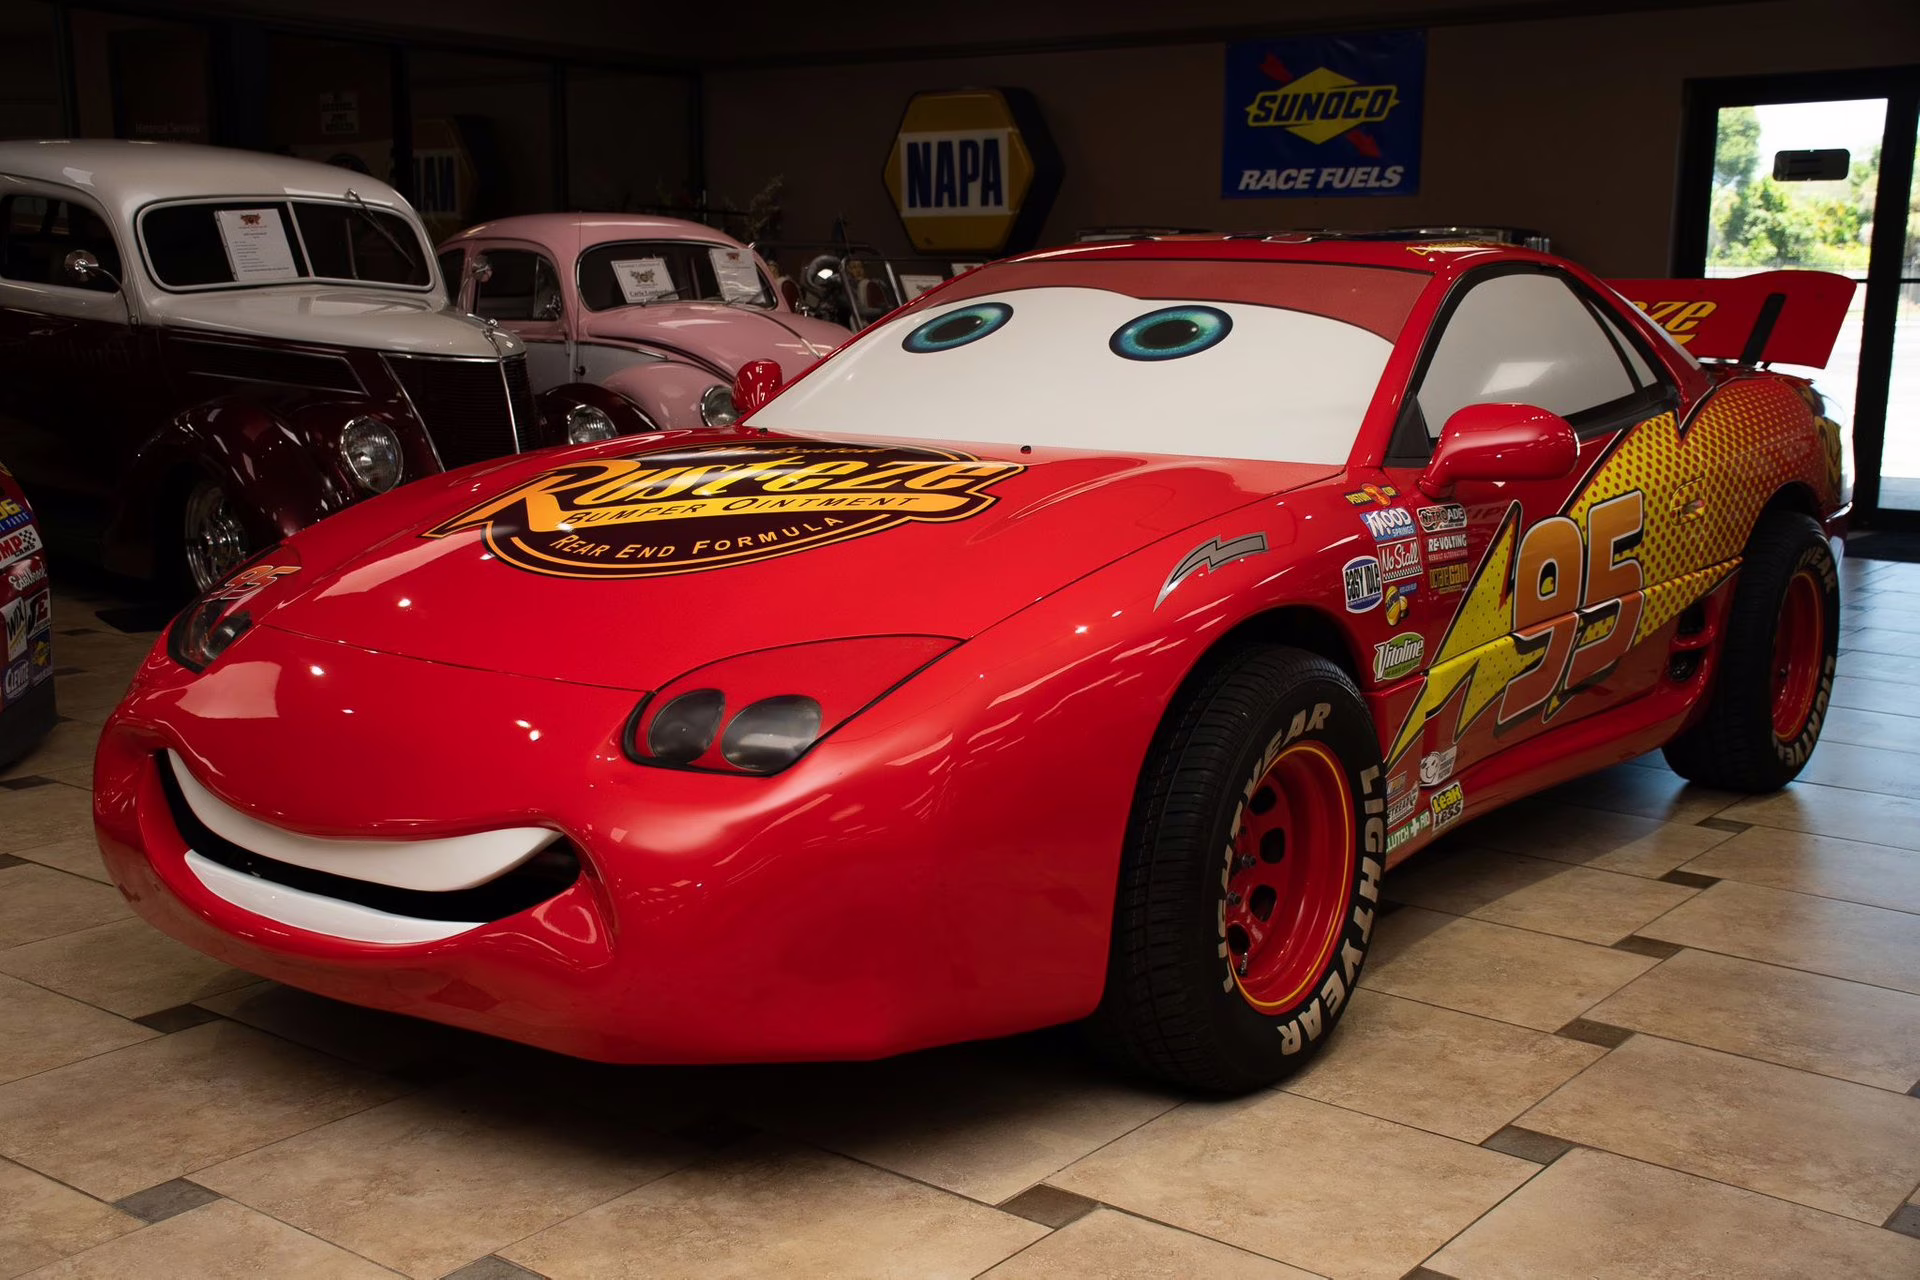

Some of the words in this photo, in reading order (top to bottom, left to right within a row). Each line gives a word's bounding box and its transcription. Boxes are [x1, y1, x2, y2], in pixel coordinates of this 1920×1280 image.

[1250, 86, 1394, 126] SUNOCO
[906, 138, 1003, 209] NAPA
[1238, 167, 1317, 191] RACE
[1319, 165, 1405, 189] FUELS
[562, 503, 707, 525] BUMPER
[722, 497, 921, 512] OINTMENT
[1366, 508, 1413, 538] MOOD
[550, 534, 610, 559] REAR
[615, 543, 675, 558] END
[692, 517, 845, 554] FORMULA
[1392, 526, 1415, 537] SPRINGS
[1382, 547, 1395, 572] No
[1394, 541, 1419, 568] Stall
[202, 565, 302, 603] 95
[7, 600, 24, 642] WIX
[1499, 489, 1645, 726] 95
[1375, 639, 1424, 680] Vitoline
[1277, 764, 1384, 1056] LIGHTYEAR
